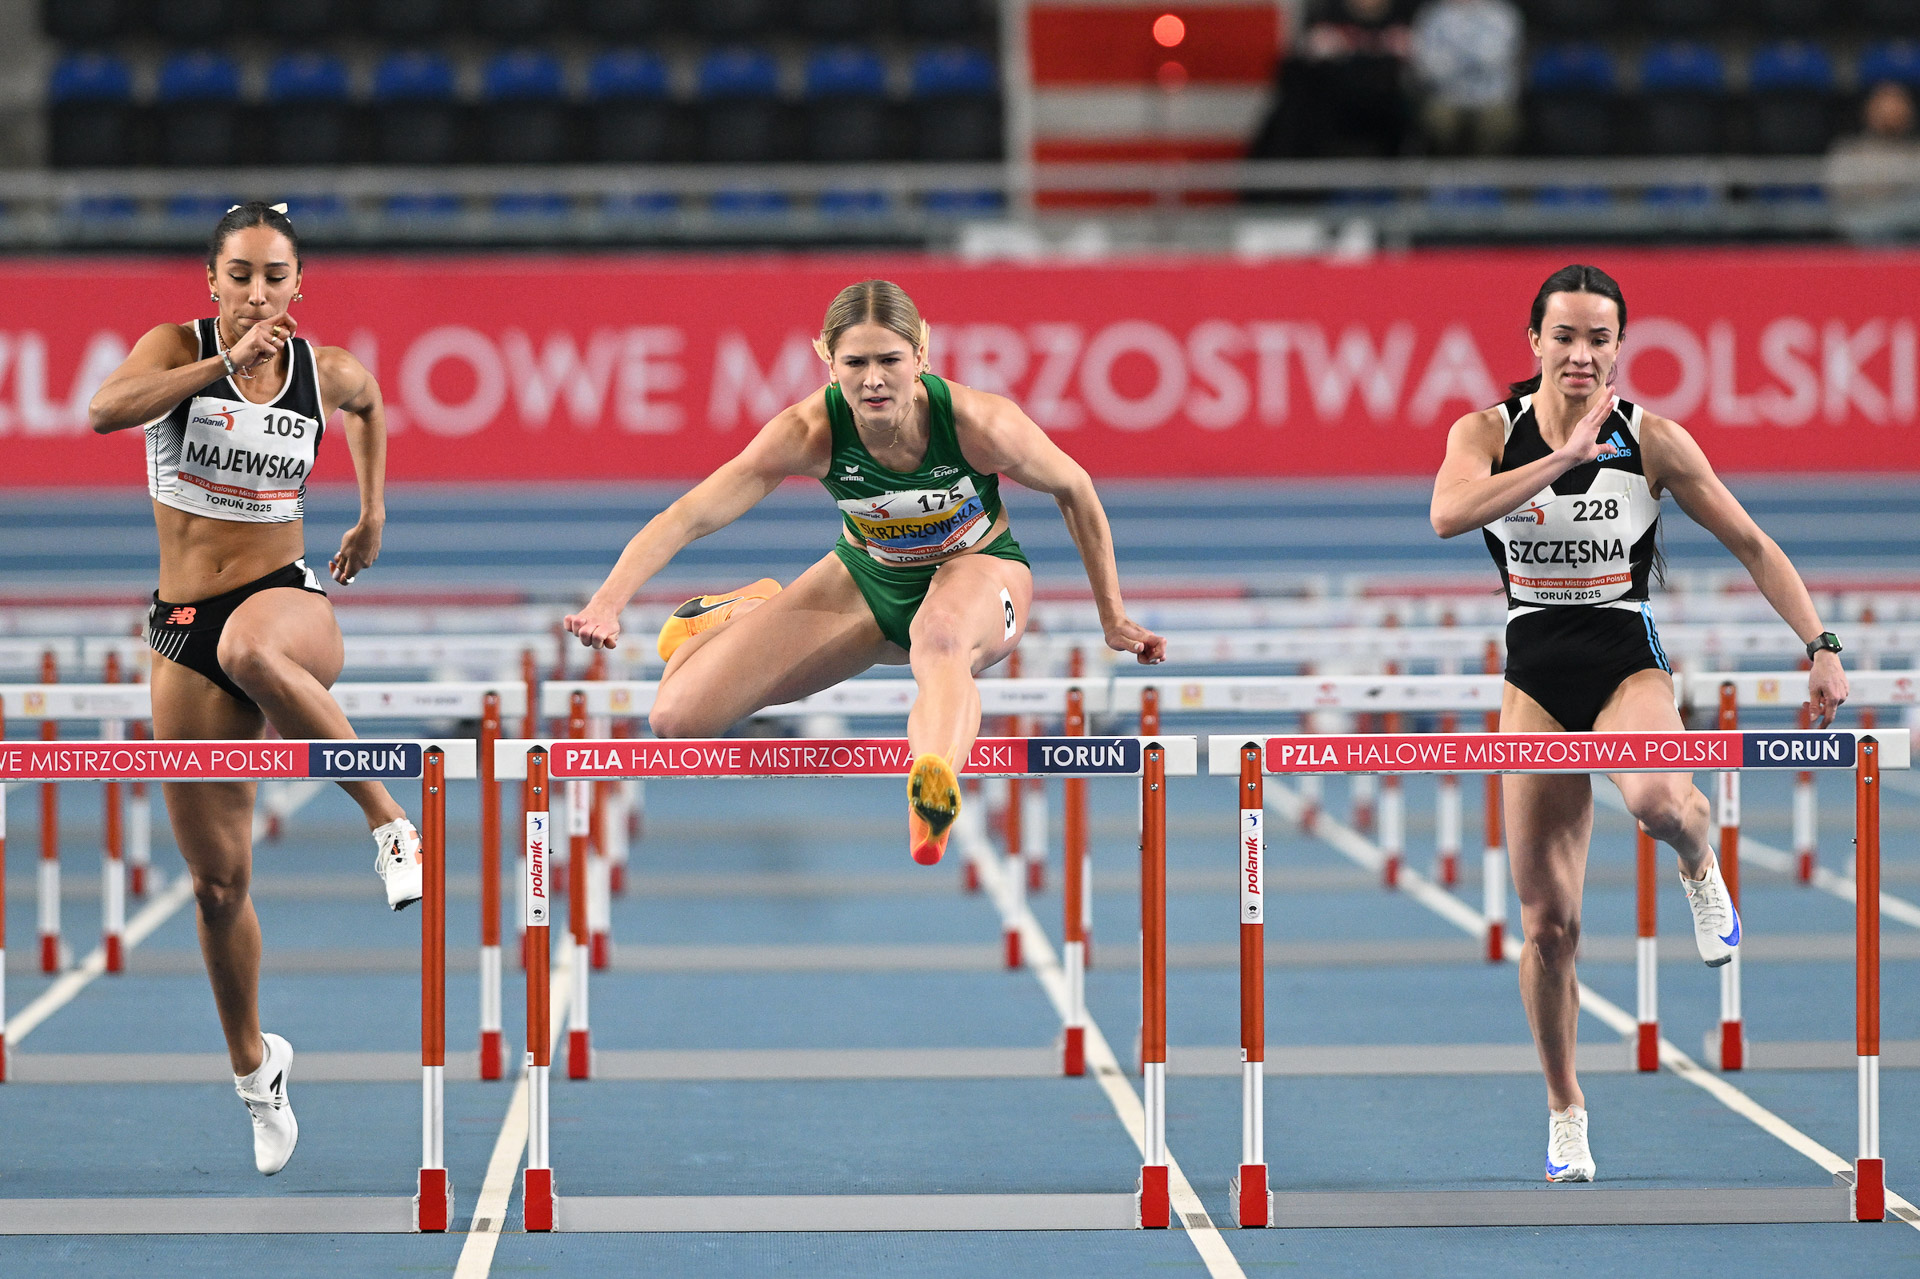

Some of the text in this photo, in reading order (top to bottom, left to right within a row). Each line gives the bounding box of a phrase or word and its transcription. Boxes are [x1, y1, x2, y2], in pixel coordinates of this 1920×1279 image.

[1612, 317, 1917, 427] OLSKI
[192, 416, 225, 428] polanik
[264, 414, 306, 439] 105
[186, 441, 305, 479] MAJEWSKA
[934, 468, 958, 478] Enea
[195, 478, 210, 488] PZLA
[211, 485, 238, 494] Halowe
[239, 489, 277, 499] Mistrzostwa
[917, 486, 964, 513] 175
[206, 494, 272, 512] TORUŃ 2025
[1573, 499, 1619, 522] 228
[860, 503, 978, 540] SKRZYSZOWSKA
[1505, 514, 1536, 523] polanik
[1509, 538, 1625, 569] SZCZĘSNA
[1521, 578, 1536, 586] PZLA
[1537, 579, 1563, 587] Halowe
[1565, 577, 1605, 587] Mistrzostwa
[1606, 574, 1627, 583] Polski
[1534, 590, 1601, 600] TORUŃ 2025
[30, 750, 203, 772] MISTRZOSTWA
[211, 749, 294, 772] POLSKI
[323, 744, 406, 771] TORUŃ
[566, 749, 623, 770] PZLA
[632, 748, 741, 770] HALOWE
[968, 745, 1012, 767] LSKI
[1041, 740, 1125, 767] TORUŃ
[1281, 734, 1840, 766] PZLA HALOWE MISTRZOSTWA POLSKI TORUŃ
[530, 840, 546, 899] polanik
[1245, 836, 1260, 895] polanik
